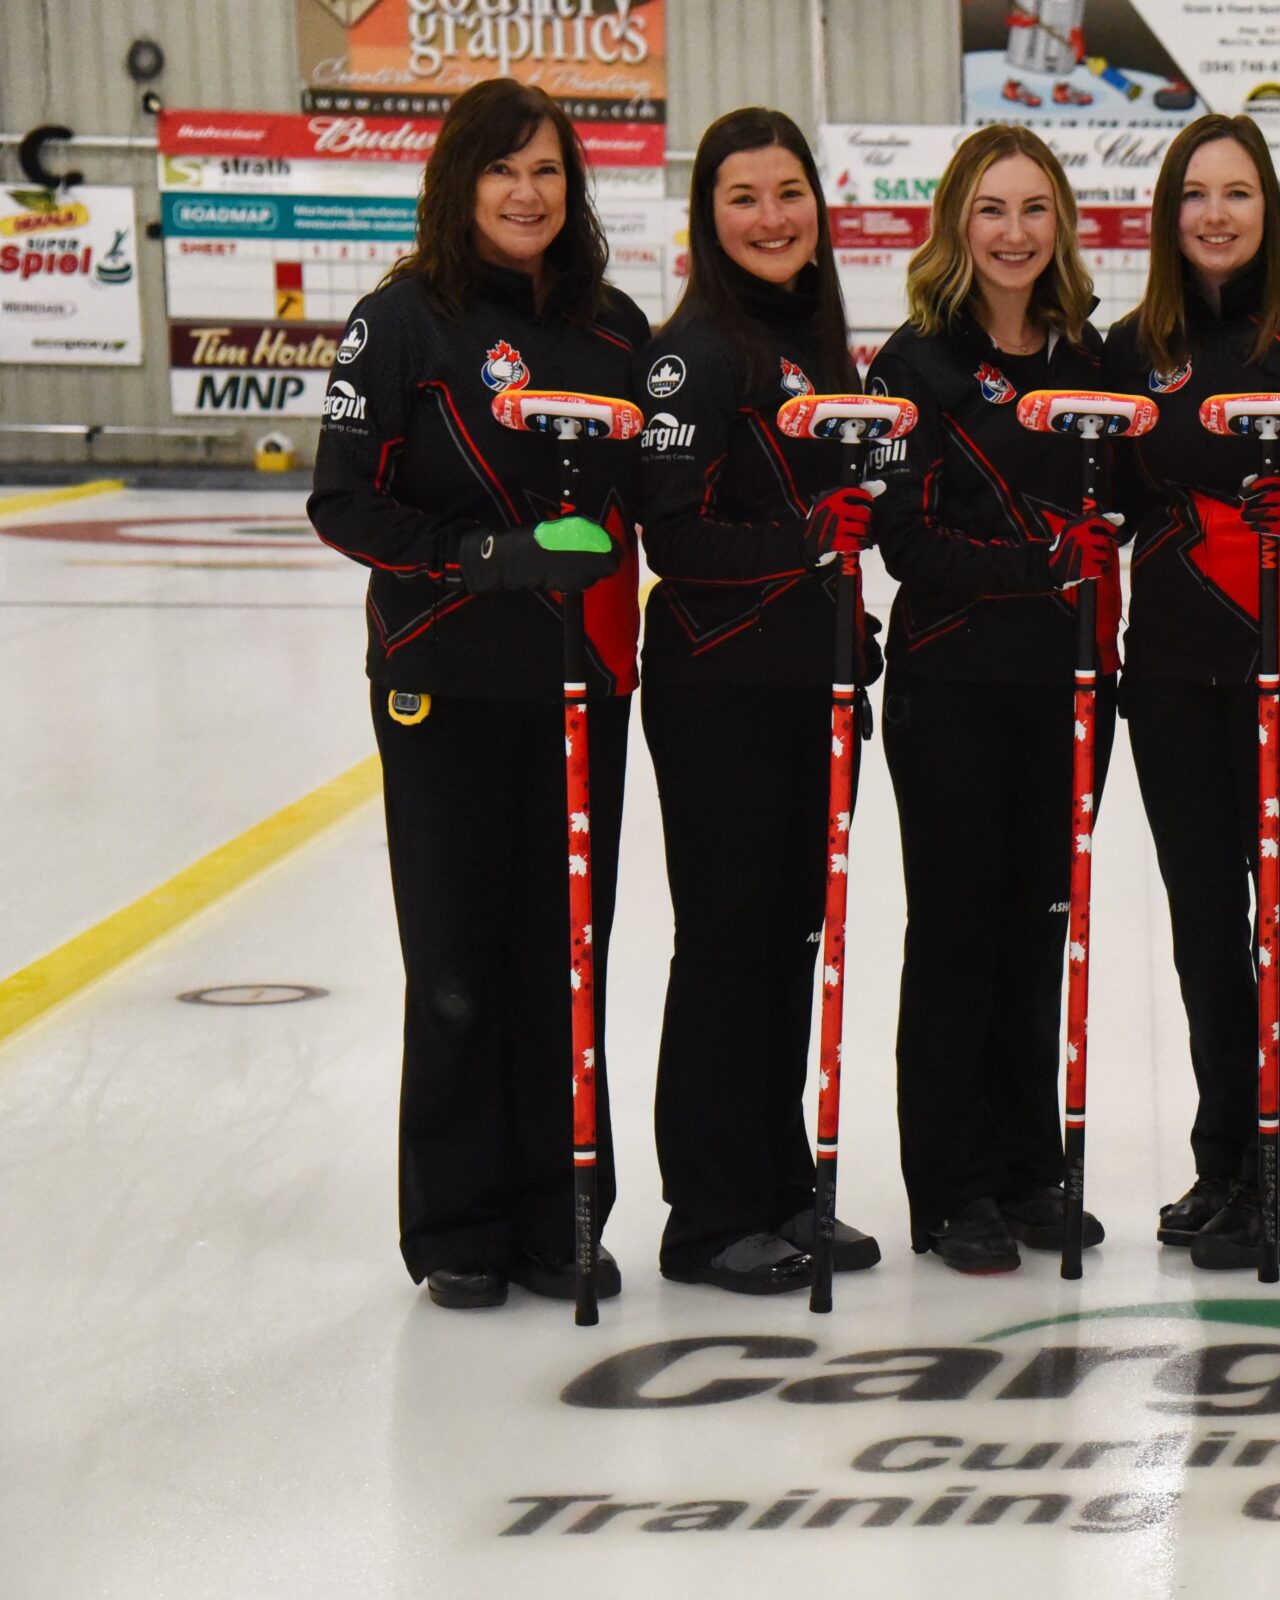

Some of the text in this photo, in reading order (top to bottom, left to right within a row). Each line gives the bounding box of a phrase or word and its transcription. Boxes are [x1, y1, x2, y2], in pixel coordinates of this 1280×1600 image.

[408, 10, 648, 78] graphics
[18, 126, 84, 188] C
[180, 207, 272, 224] ROADMAP
[27, 238, 79, 251] SUPER
[179, 241, 238, 257] SHEET
[0, 244, 93, 281] Spiel
[839, 253, 893, 267] SHEET
[189, 327, 338, 368] Tim Horto
[195, 374, 305, 410] MNP
[322, 394, 367, 421] argill
[641, 423, 697, 452] argill
[869, 439, 907, 470] rgill
[1048, 901, 1071, 914] ASH
[498, 1487, 1182, 1535] Training
